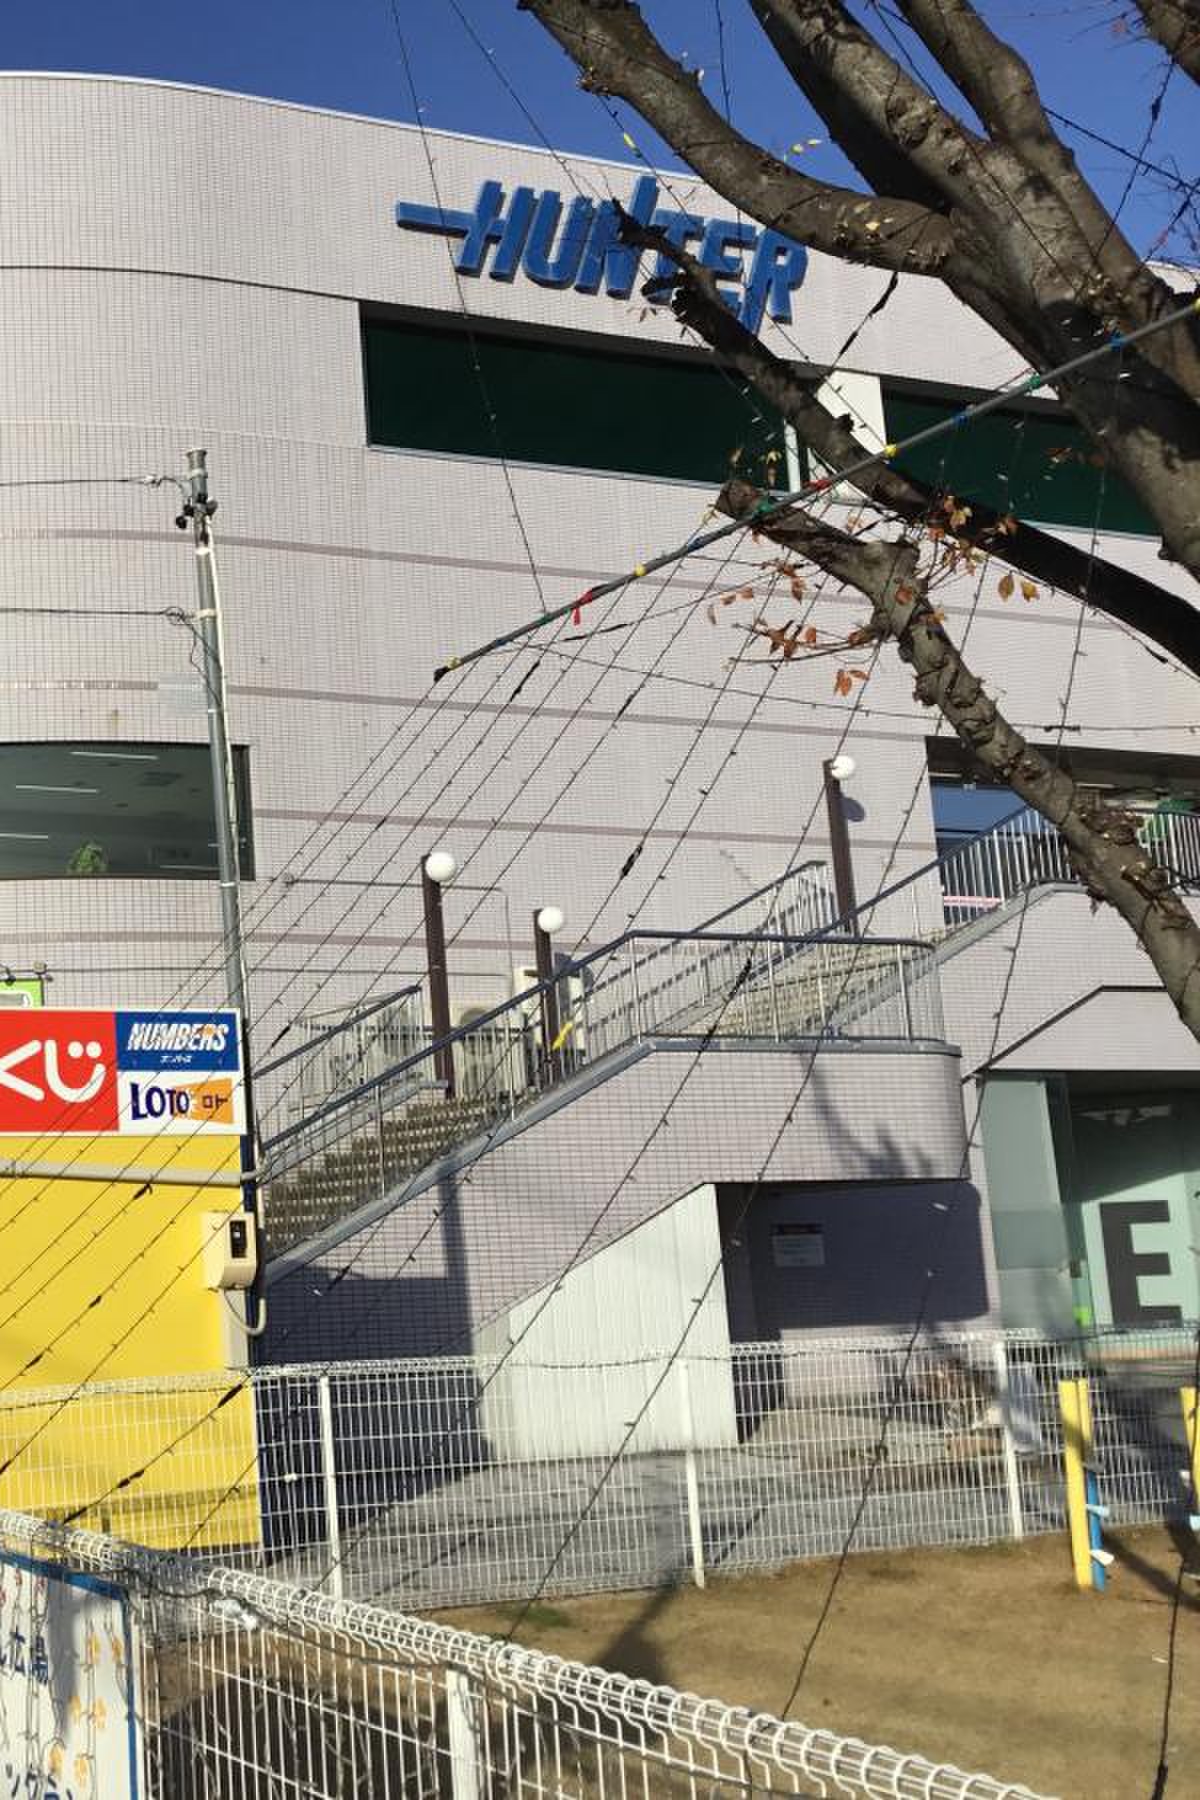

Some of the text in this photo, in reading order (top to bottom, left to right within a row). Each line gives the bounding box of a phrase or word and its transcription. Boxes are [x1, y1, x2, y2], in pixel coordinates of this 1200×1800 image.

[397, 175, 809, 336] HUNTER
[127, 1022, 230, 1052] NUMBERS
[130, 1081, 190, 1121] LOTO
[1100, 1200, 1183, 1328] E
